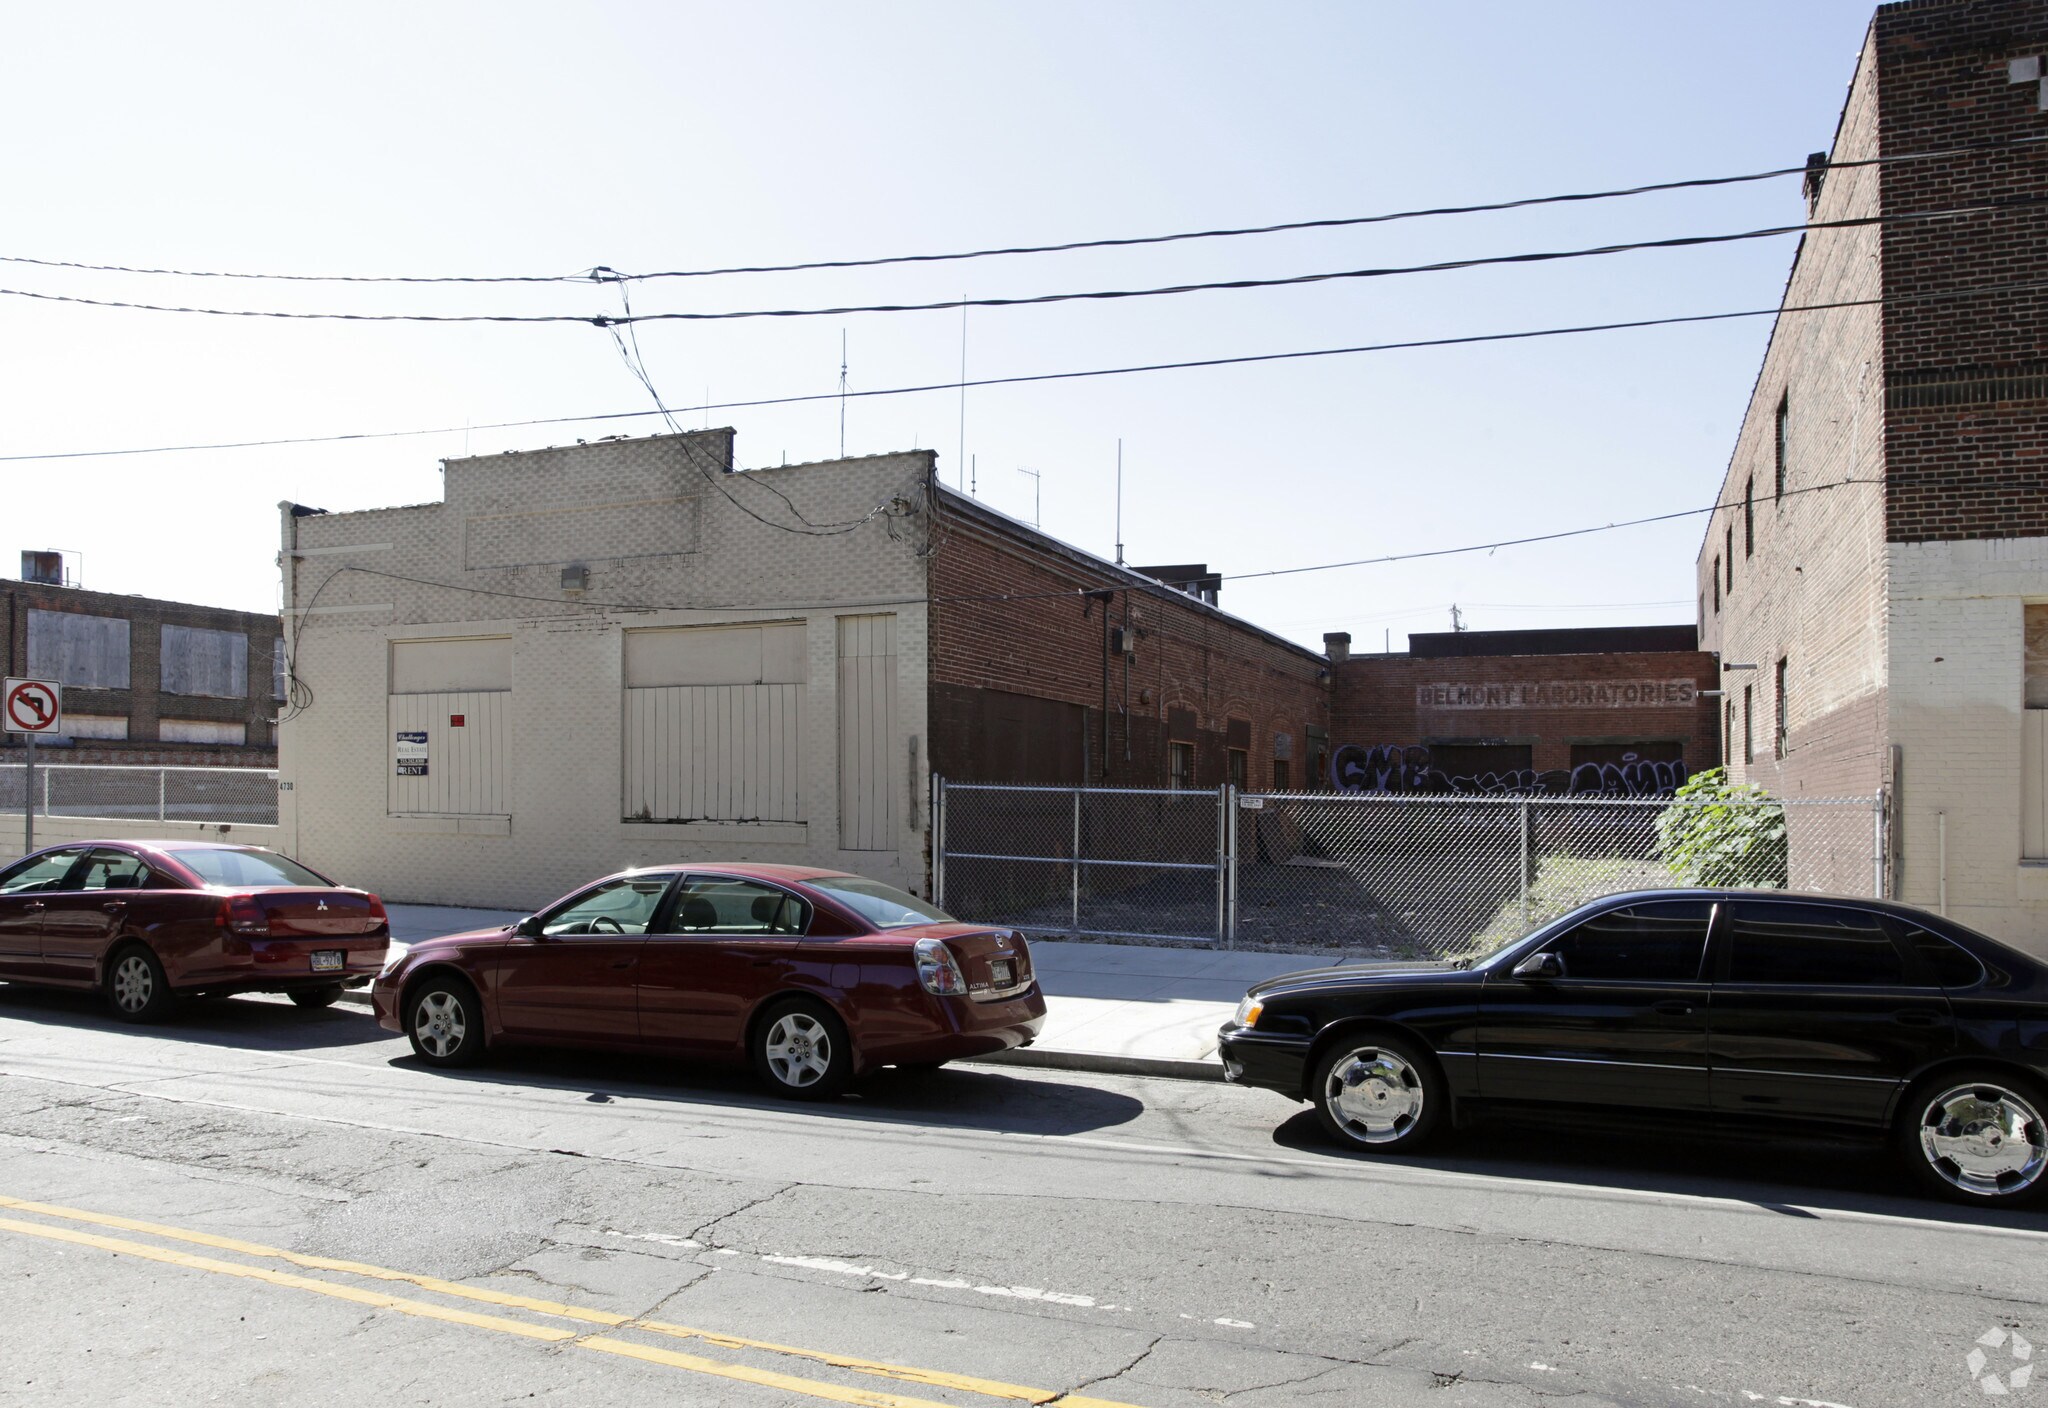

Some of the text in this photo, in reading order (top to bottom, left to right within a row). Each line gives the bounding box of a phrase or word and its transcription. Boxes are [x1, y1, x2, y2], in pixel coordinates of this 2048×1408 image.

[1419, 683, 1694, 706] BELMONT LABORATORIES
[402, 766, 423, 775] RENT
[969, 982, 989, 990] ALTIMA
